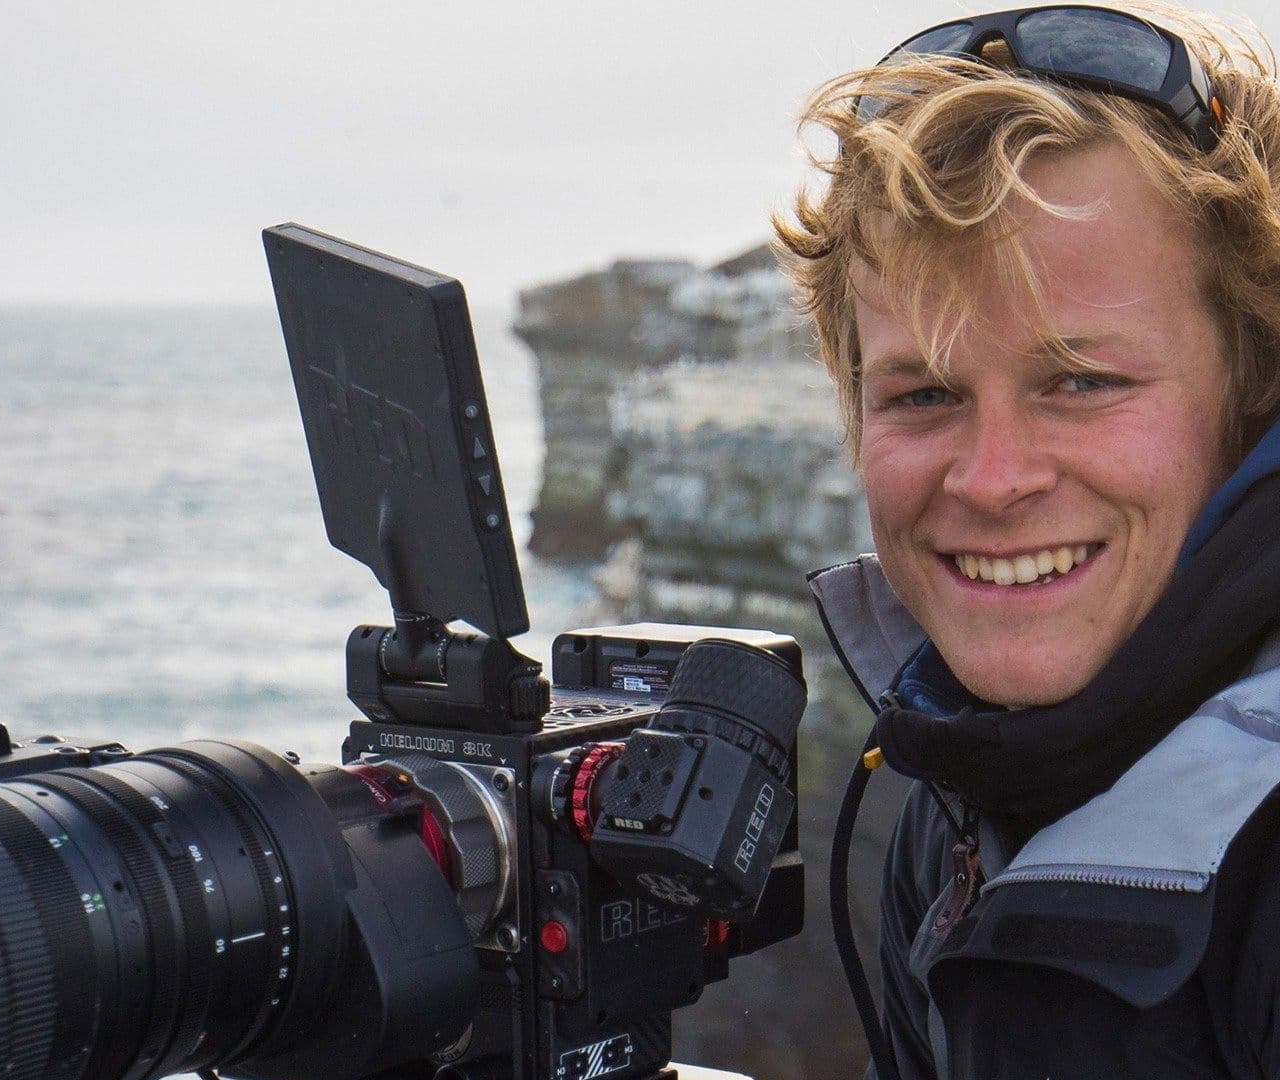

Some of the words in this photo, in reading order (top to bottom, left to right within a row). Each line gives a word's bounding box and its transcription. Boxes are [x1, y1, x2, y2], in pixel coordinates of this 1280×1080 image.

[380, 732, 455, 754] HELIUM
[463, 741, 492, 758] 8K
[614, 817, 644, 830] RED
[734, 782, 775, 874] RED
